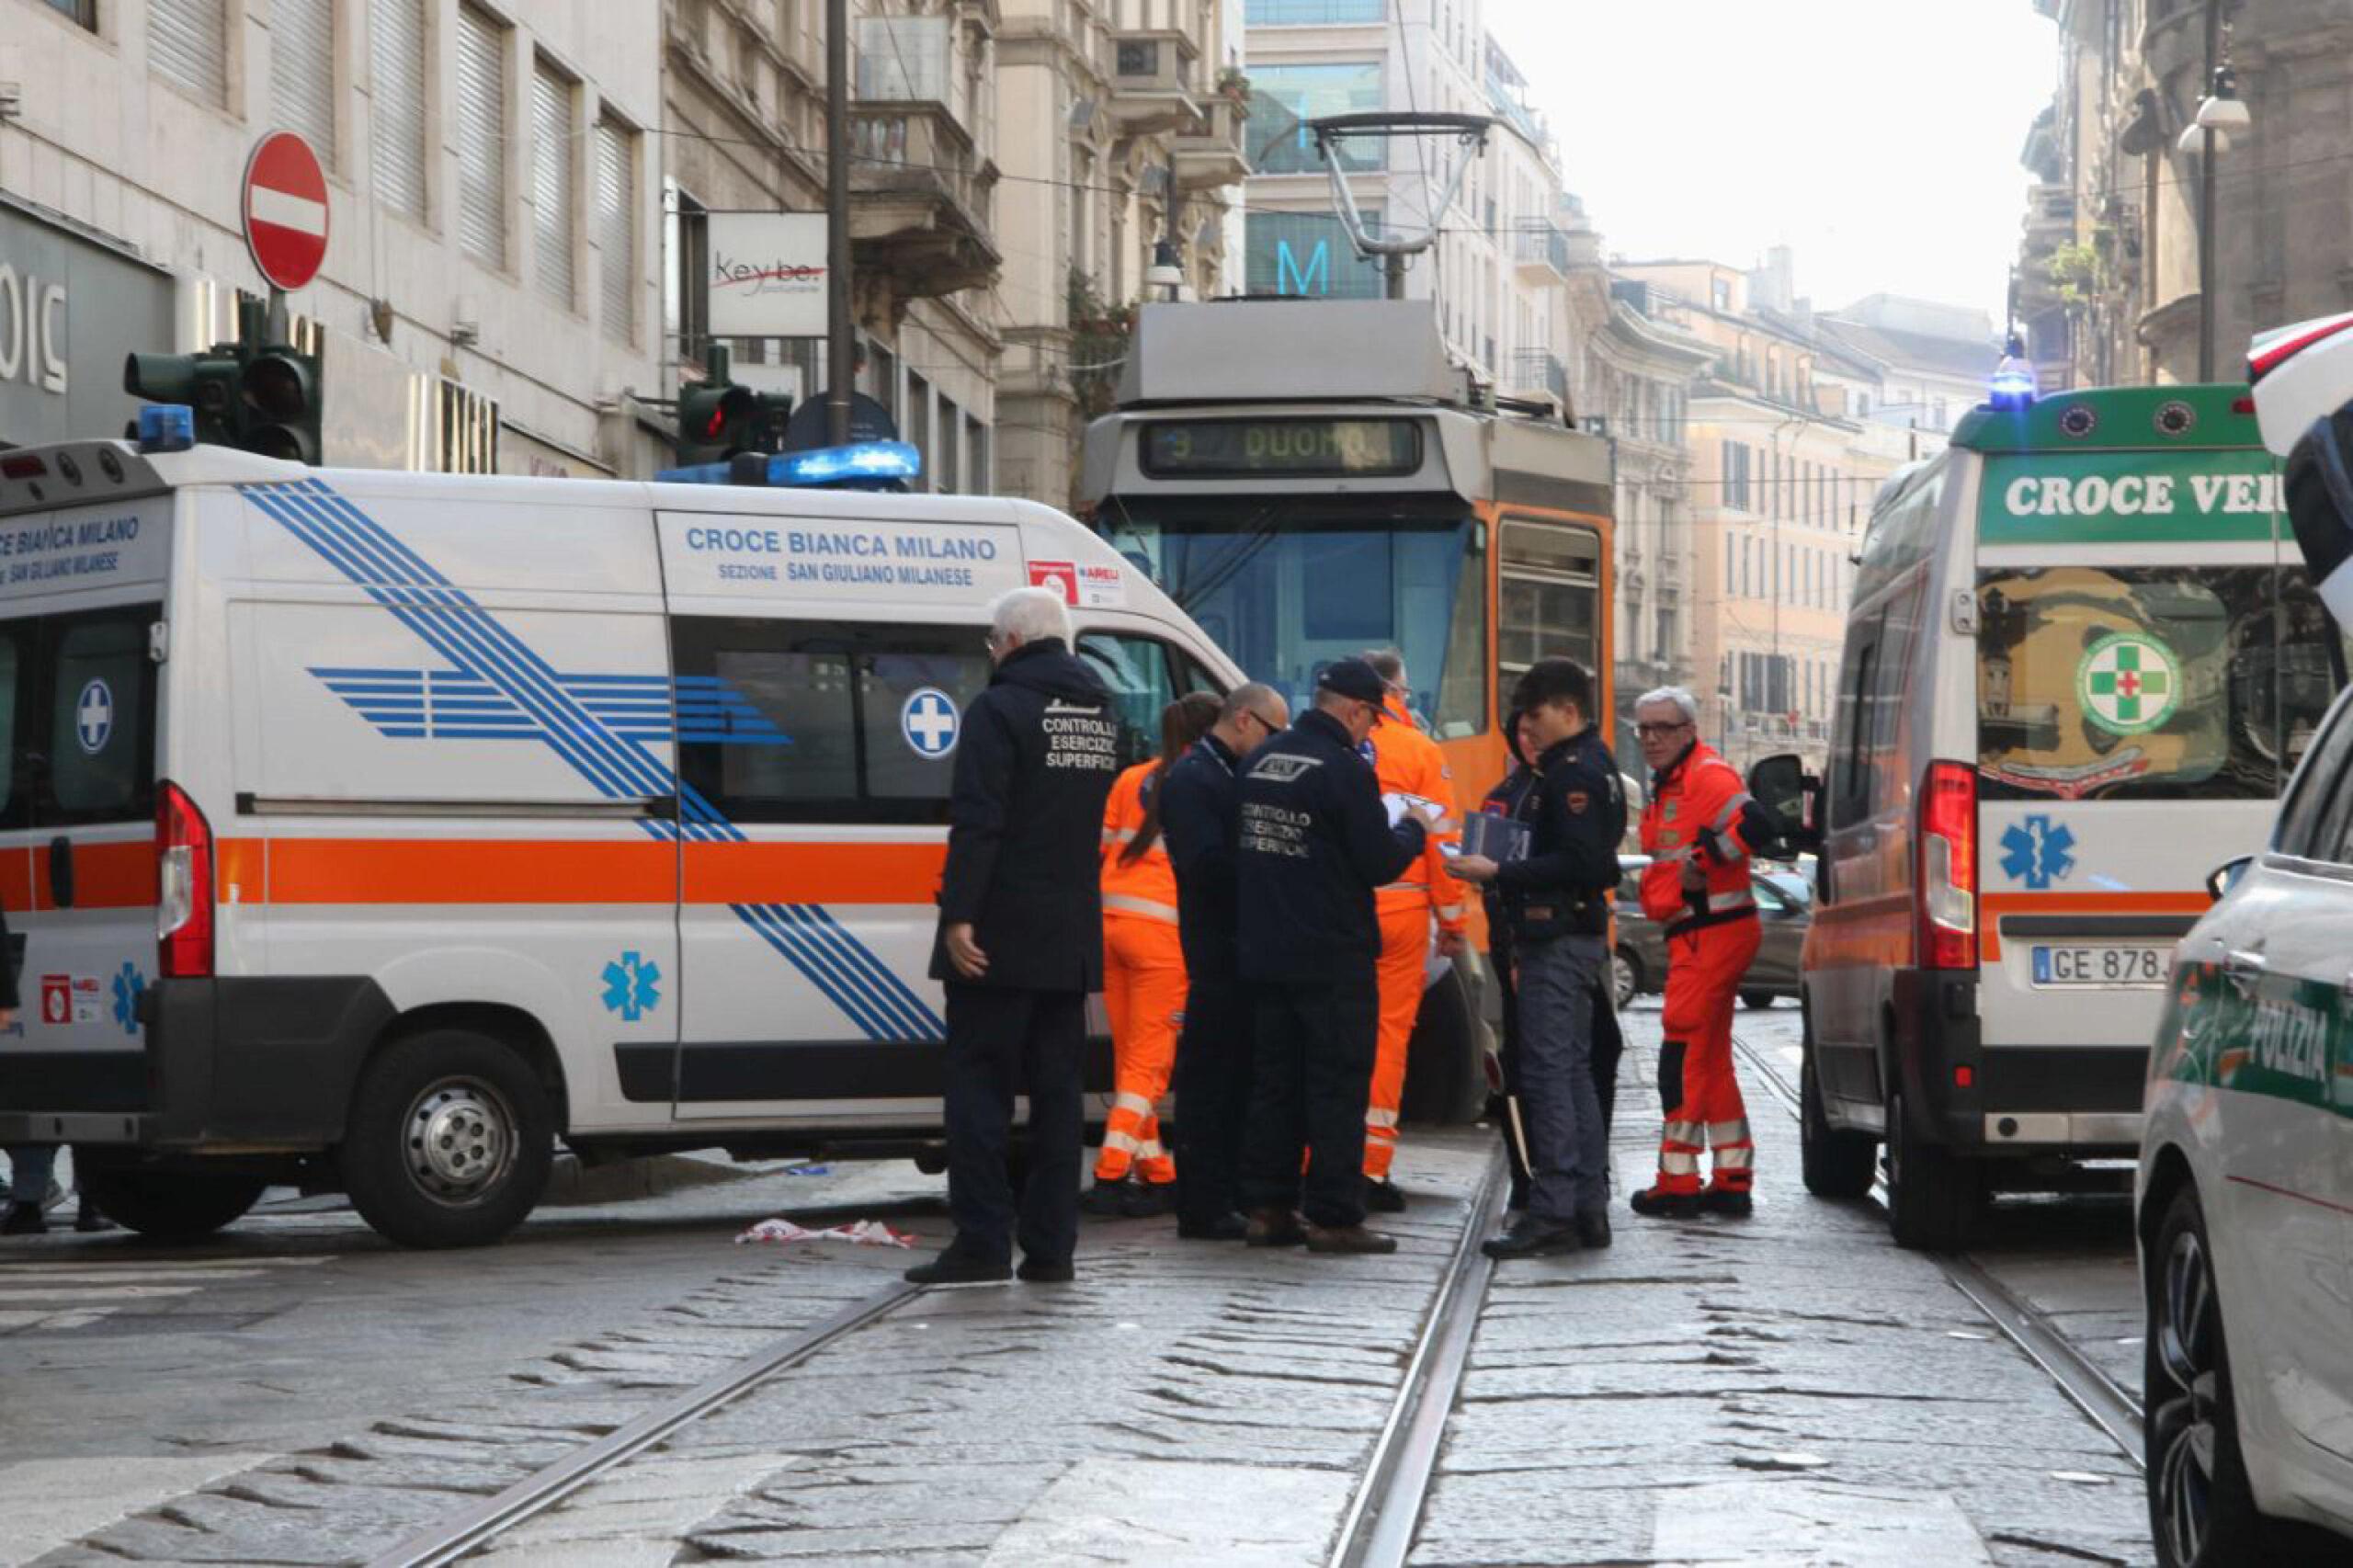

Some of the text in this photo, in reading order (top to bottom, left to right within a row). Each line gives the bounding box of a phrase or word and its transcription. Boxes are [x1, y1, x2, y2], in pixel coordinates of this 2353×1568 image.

[1279, 240, 1328, 295] M
[2006, 475, 2175, 516] CROCE
[78, 515, 139, 546] MILANO
[687, 528, 996, 561] CROCE BIANCA MILANO
[719, 562, 973, 586] SEZIONE SAN GIULIANO MILANESE
[2055, 949, 2091, 979] GE
[2103, 949, 2168, 979] 878
